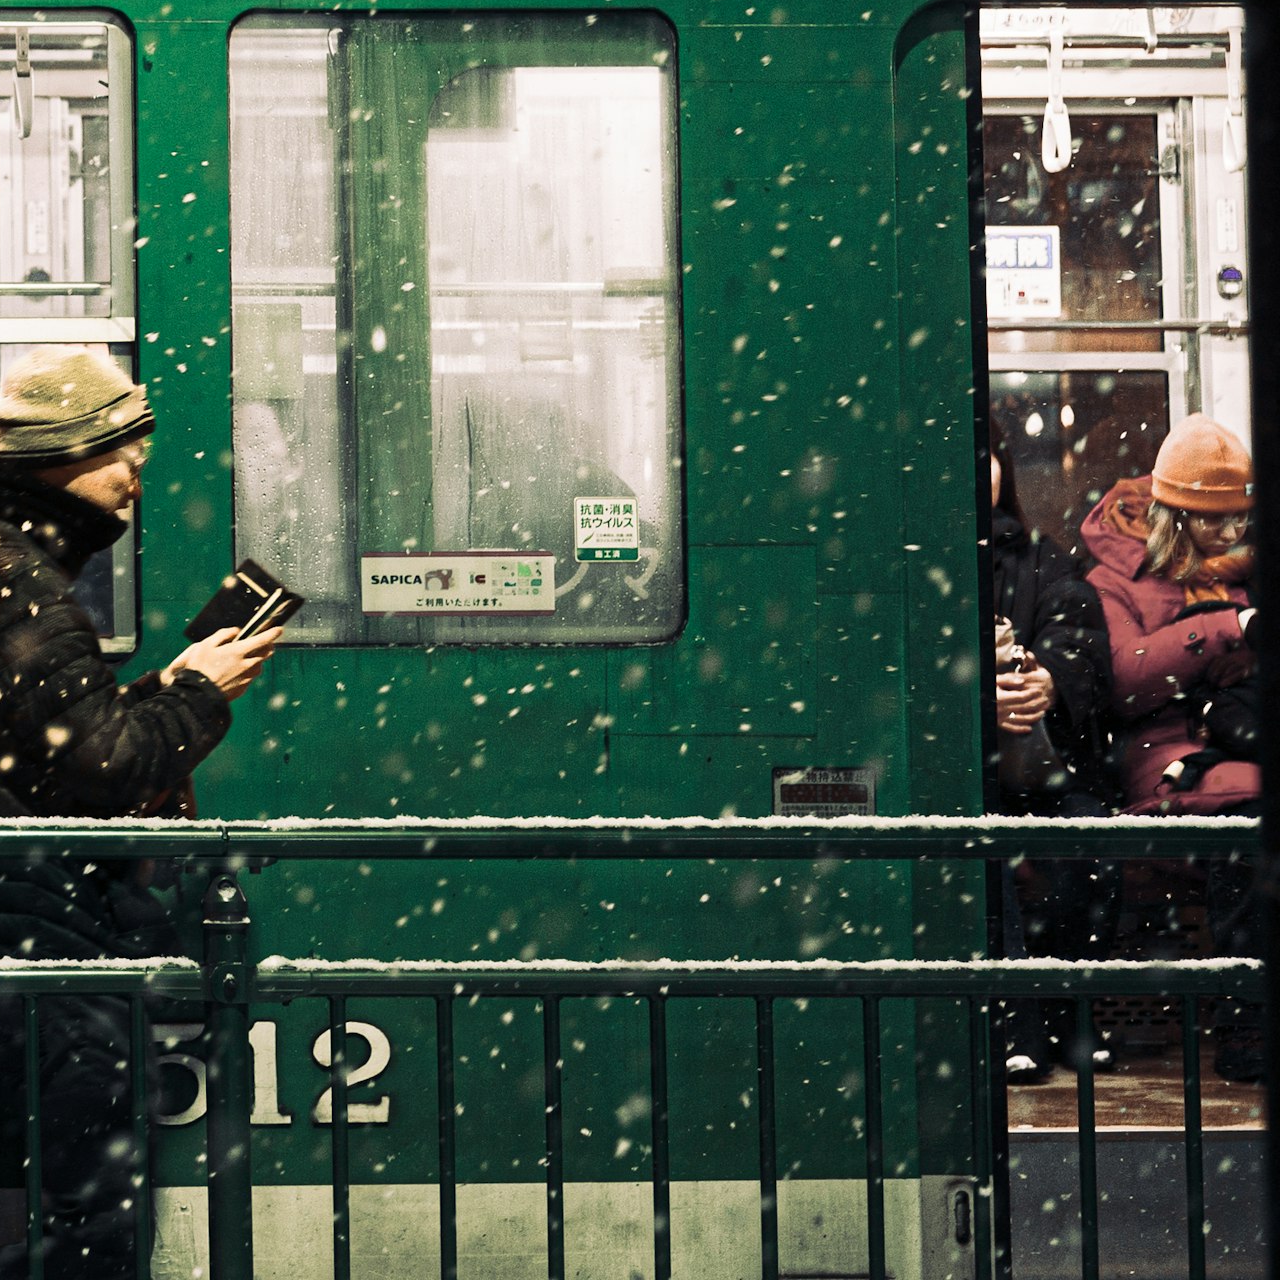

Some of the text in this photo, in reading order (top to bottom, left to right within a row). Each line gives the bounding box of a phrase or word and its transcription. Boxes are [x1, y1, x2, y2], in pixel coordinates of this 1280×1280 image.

[580, 503, 633, 515] 抗菌・消臭
[371, 575, 422, 585] SAPICA
